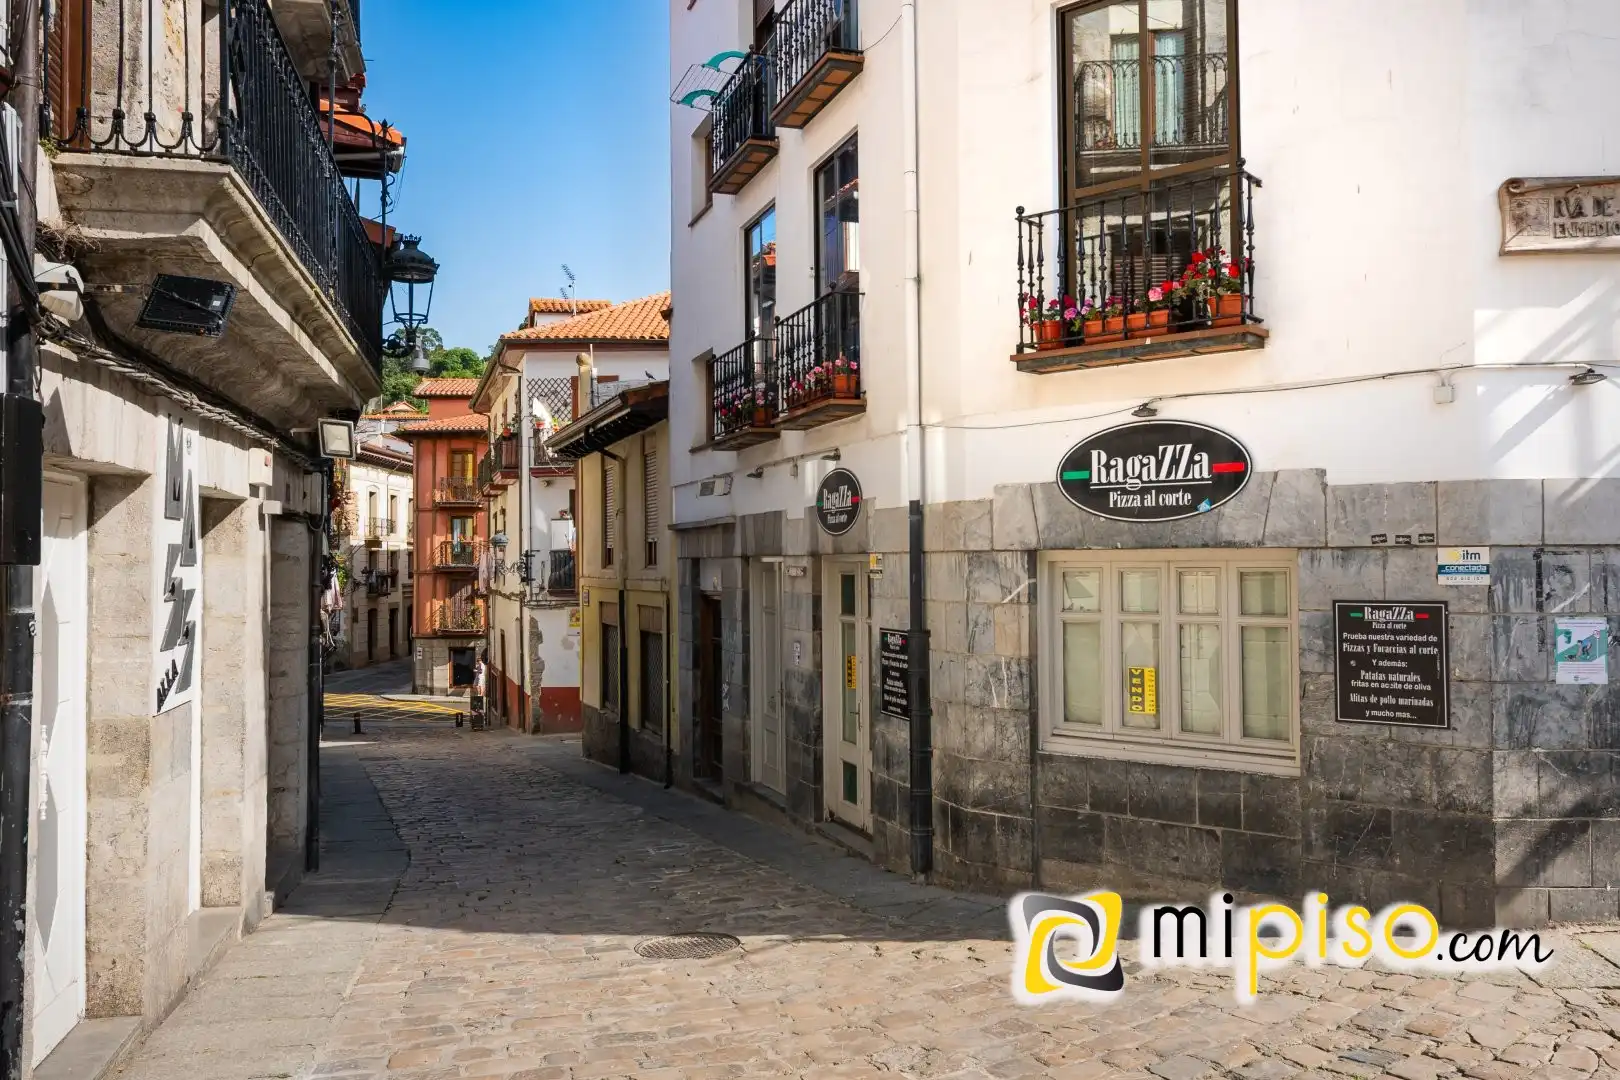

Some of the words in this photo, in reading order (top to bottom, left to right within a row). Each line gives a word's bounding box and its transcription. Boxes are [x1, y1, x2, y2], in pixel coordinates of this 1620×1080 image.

[1090, 443, 1212, 491] RagaZZa
[1109, 490, 1142, 508] Pizza
[1143, 489, 1156, 507] al
[1161, 488, 1192, 506] corte
[1462, 549, 1481, 560] itm
[1343, 632, 1367, 640] Prueba
[1368, 633, 1394, 641] nuestra
[1396, 634, 1426, 642] variedad
[1343, 642, 1365, 652] Pizzas
[1409, 645, 1416, 654] al
[1418, 646, 1439, 655] corte
[1378, 659, 1408, 668] además:
[1360, 670, 1386, 680] Patatas
[1388, 671, 1421, 682] naturales
[1351, 680, 1370, 688] fritas
[1404, 682, 1412, 690] de
[1414, 682, 1432, 690] oliva
[1370, 694, 1378, 704] de
[1380, 694, 1396, 706] pollo
[1398, 696, 1434, 707] marinadas
[1371, 710, 1394, 718] mucho
